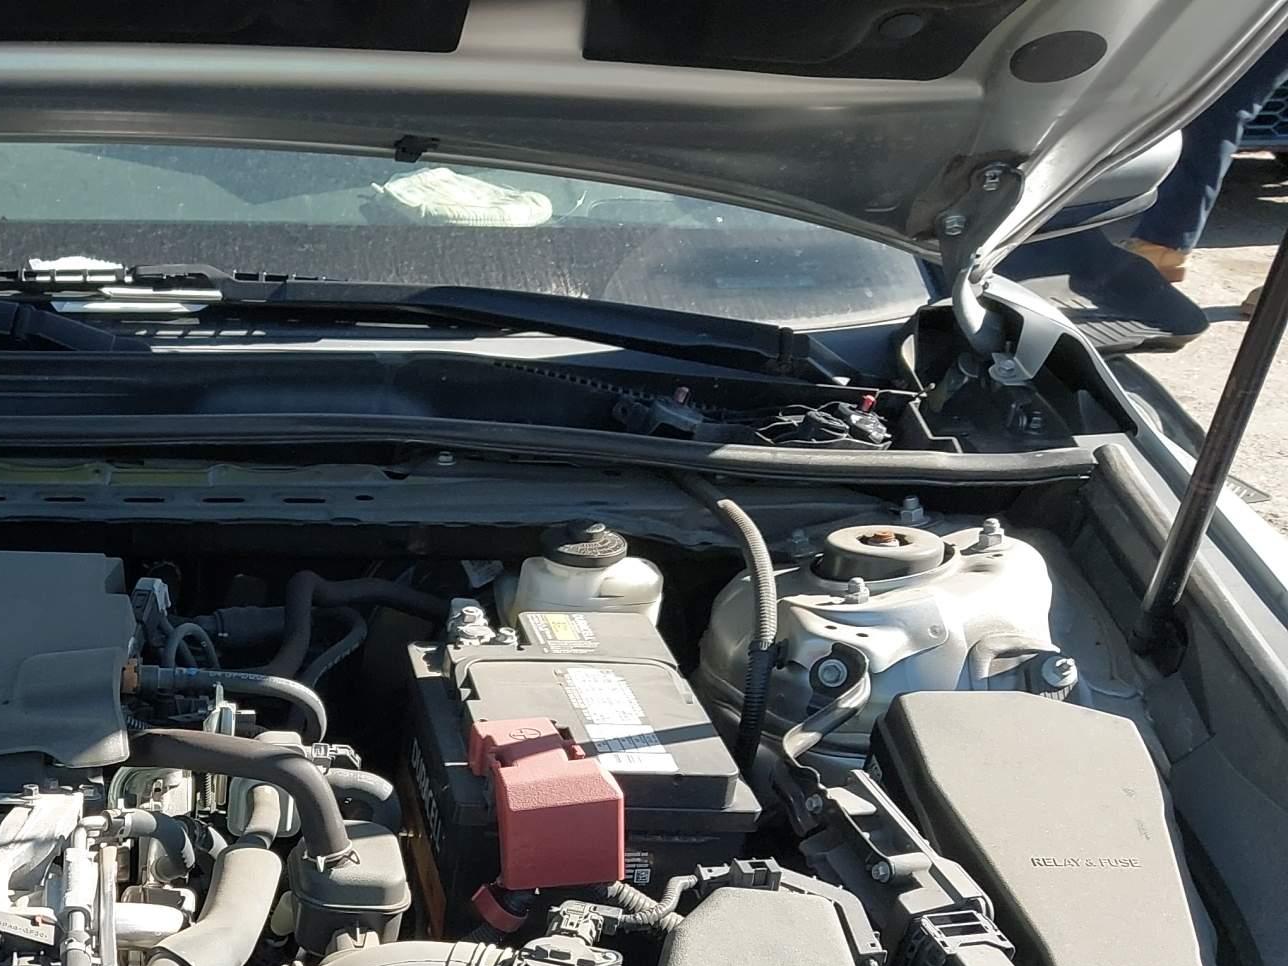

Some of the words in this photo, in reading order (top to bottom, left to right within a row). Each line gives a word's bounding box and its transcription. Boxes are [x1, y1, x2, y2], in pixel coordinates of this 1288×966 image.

[1030, 857, 1080, 868] RELAY
[1084, 858, 1097, 868] &
[1098, 858, 1141, 869] FUSE
